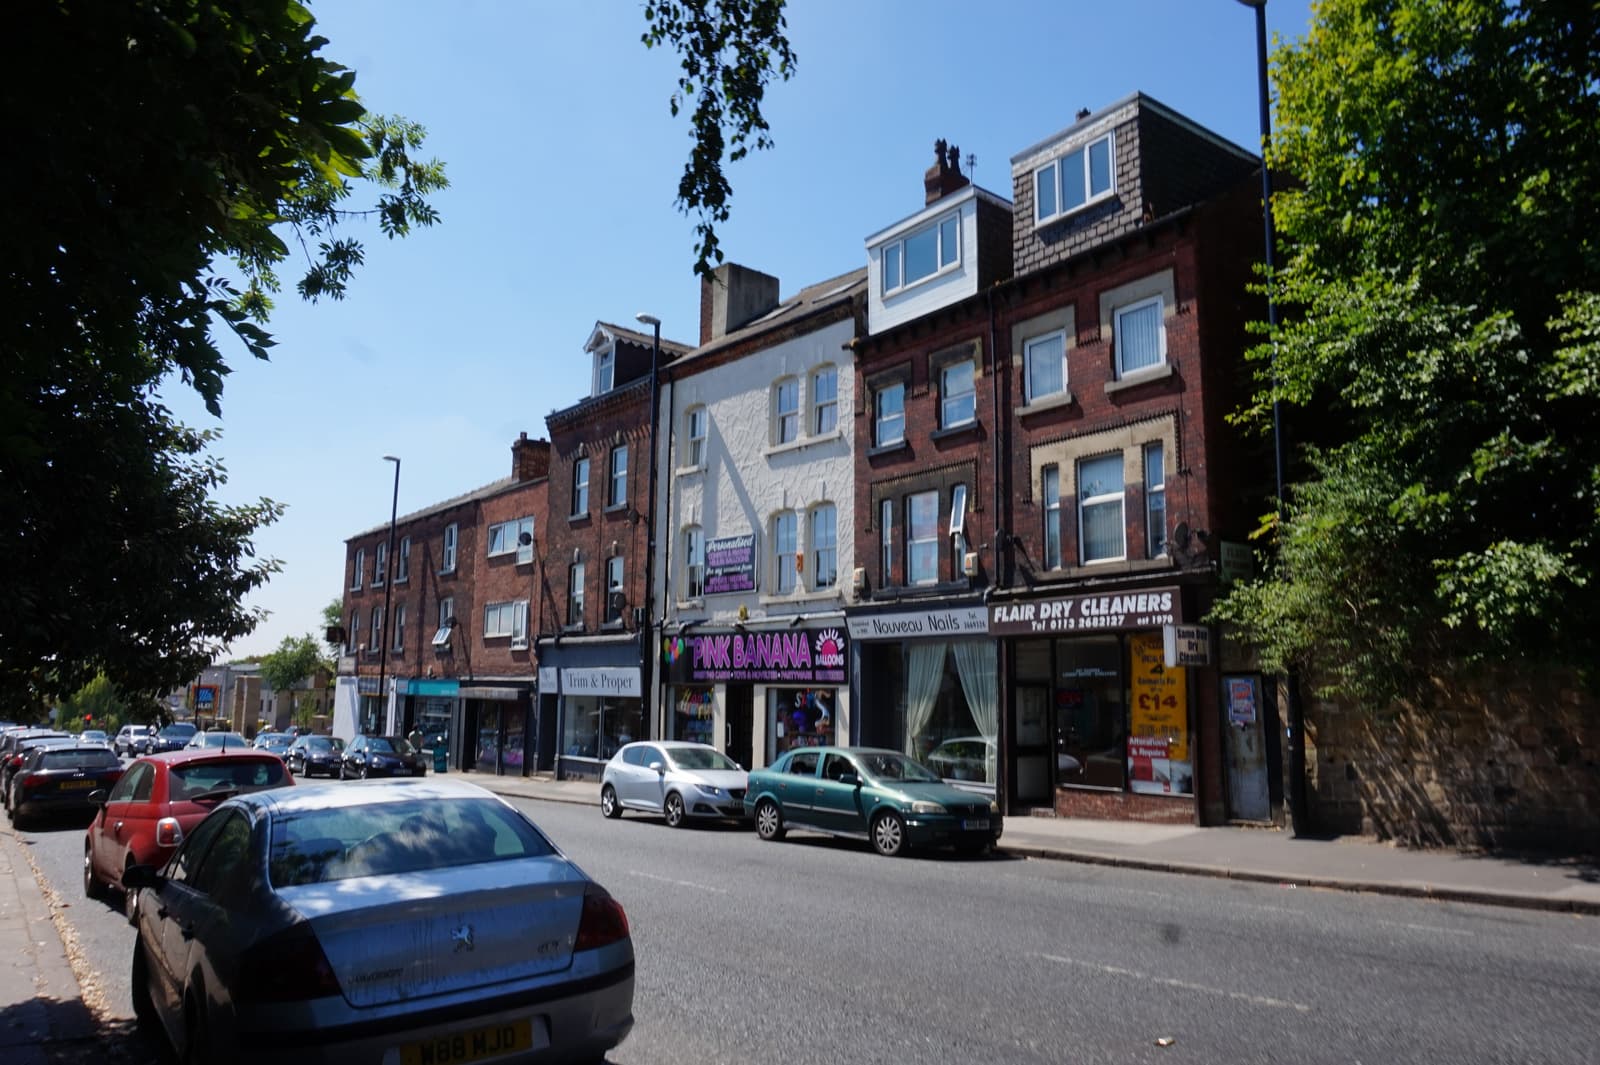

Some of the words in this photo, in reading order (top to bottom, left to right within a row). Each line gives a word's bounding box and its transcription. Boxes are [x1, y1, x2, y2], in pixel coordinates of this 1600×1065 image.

[994, 603, 1035, 623] FLAIR
[1040, 600, 1073, 619] DRY
[1080, 592, 1172, 617] CLEANERS
[872, 618, 923, 635] Nouveau
[927, 613, 960, 632] Nails
[1031, 620, 1046, 631] Tel
[1050, 617, 1075, 630] 0113
[693, 634, 731, 669] PINK
[733, 631, 812, 669] BANANA
[815, 627, 845, 651] HELIUM
[815, 653, 844, 666] BALLOONS
[568, 672, 588, 689] Trim
[590, 673, 598, 689] &
[601, 673, 633, 694] Proper
[1138, 693, 1178, 711] £14
